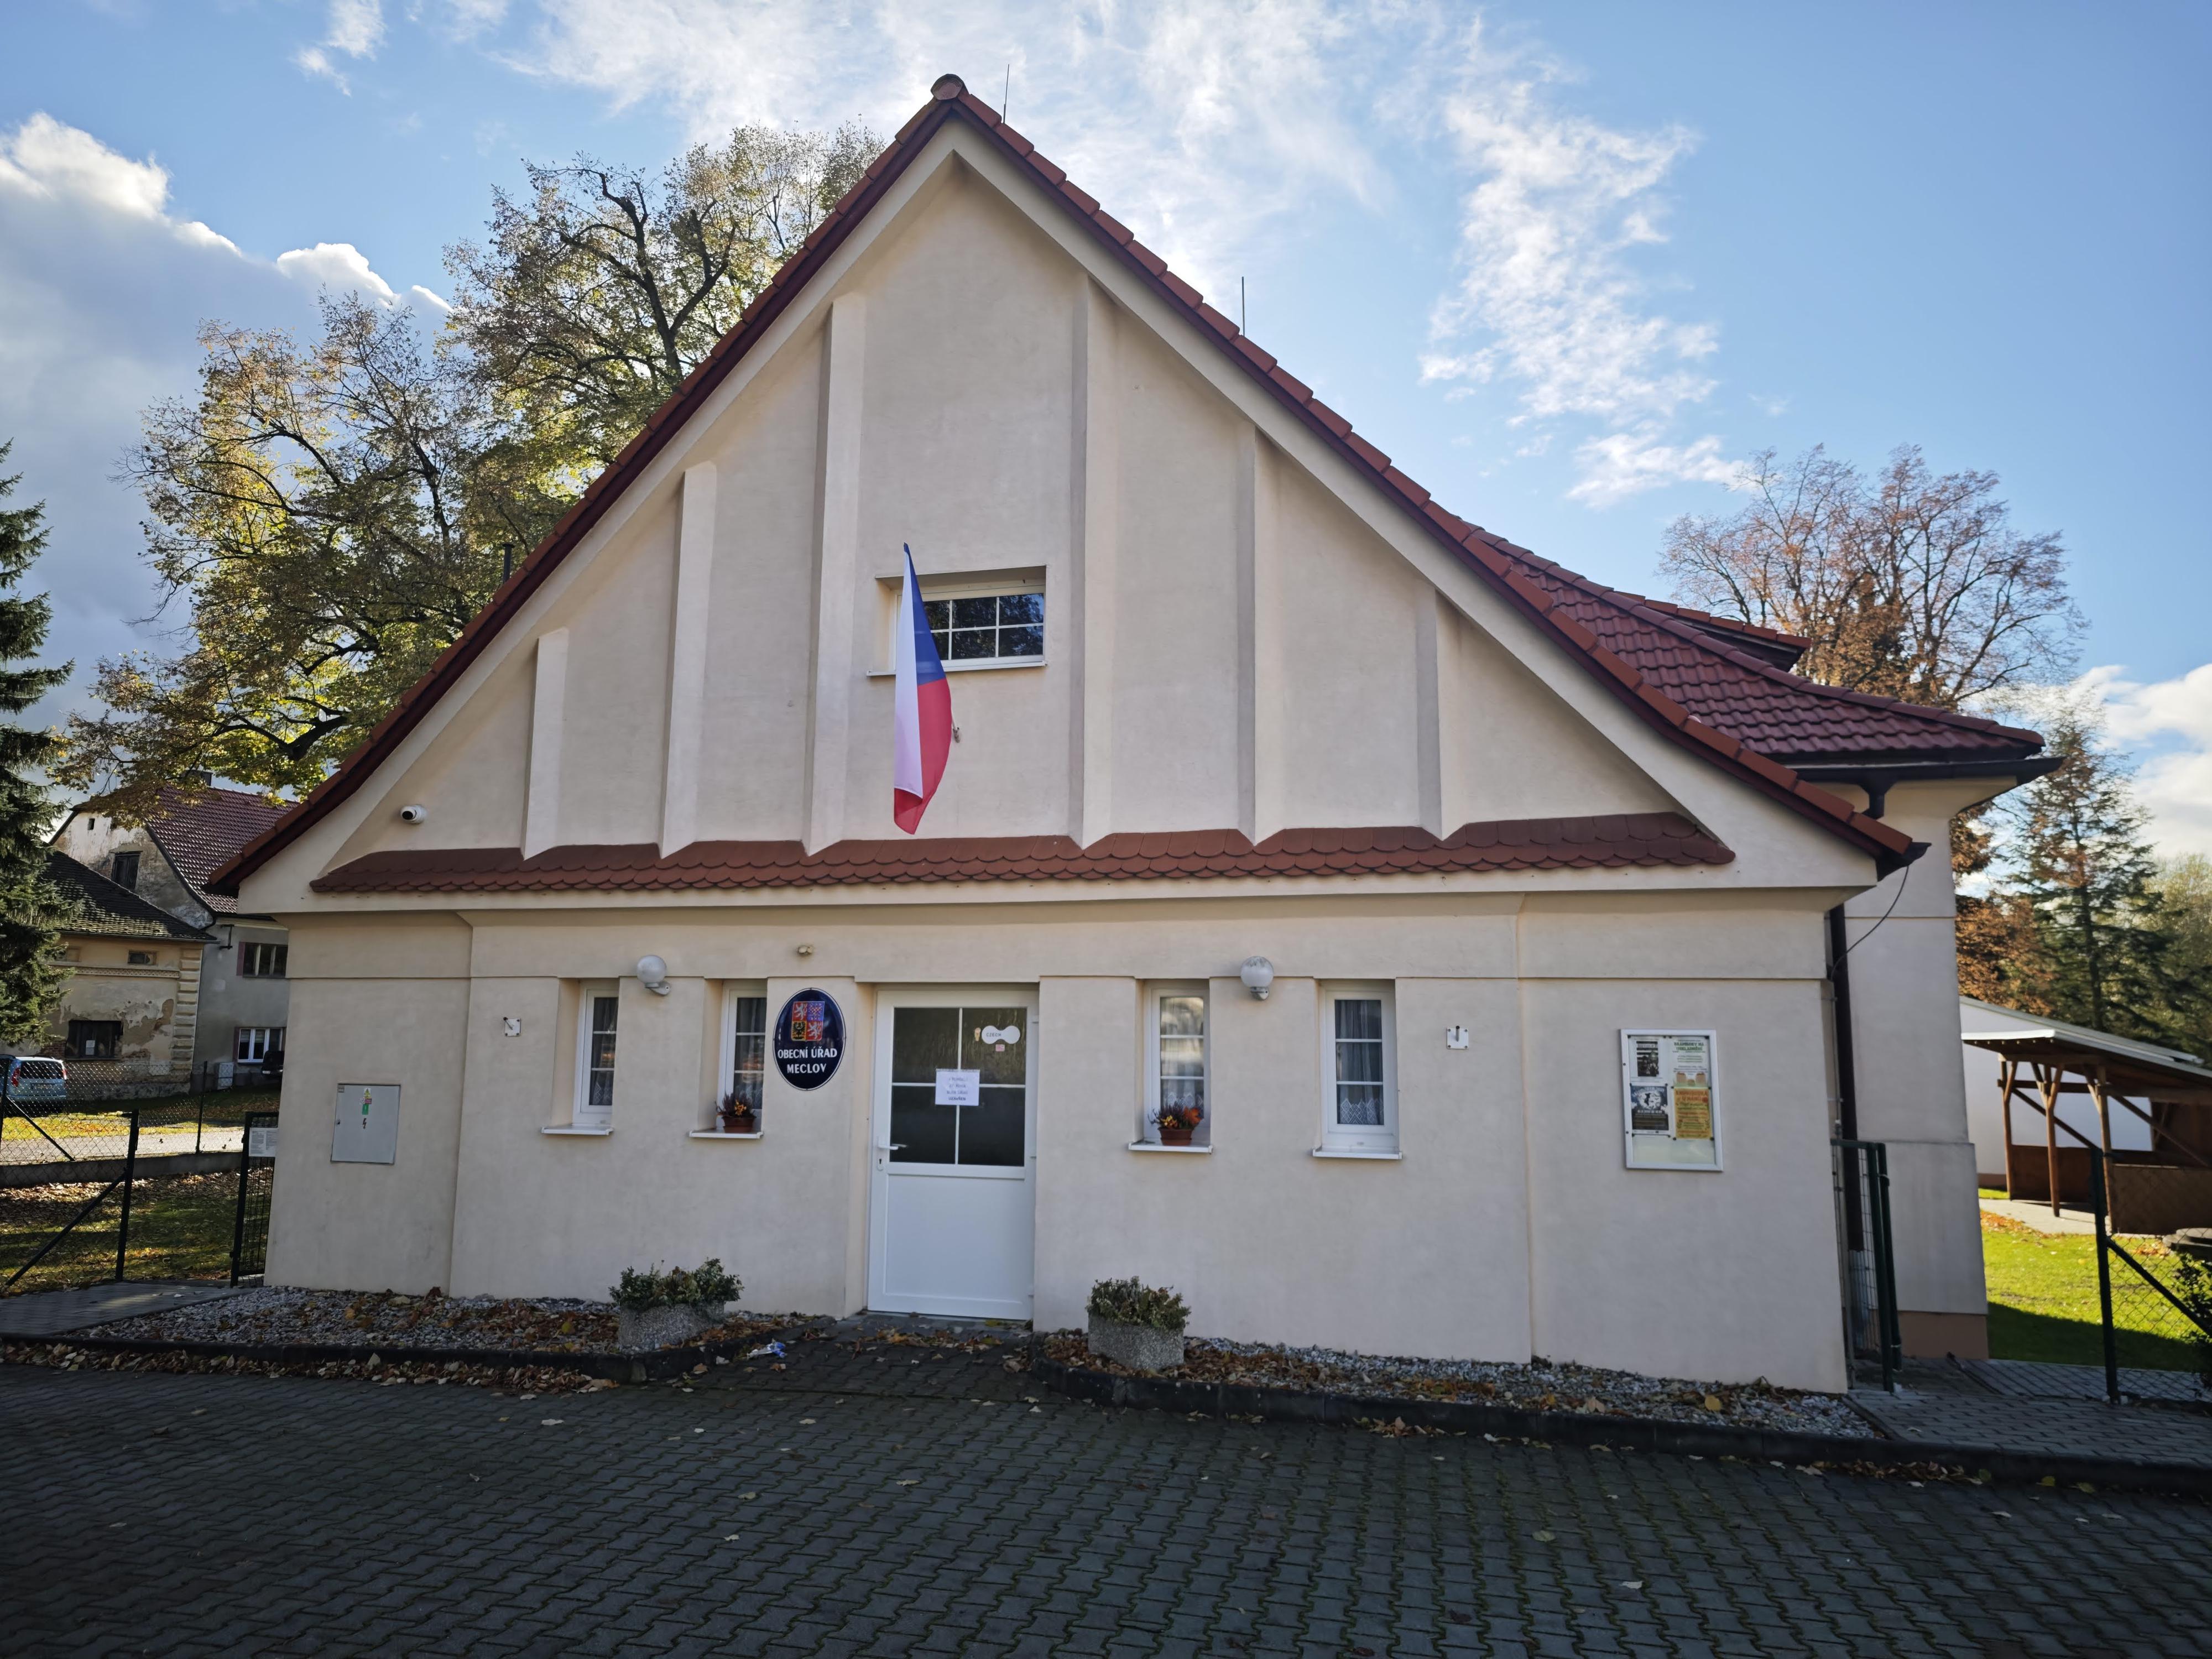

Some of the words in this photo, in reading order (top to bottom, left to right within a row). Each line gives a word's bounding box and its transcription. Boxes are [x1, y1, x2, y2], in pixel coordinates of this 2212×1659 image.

[778, 1047, 808, 1059] OBECNÍ
[811, 1046, 838, 1058] ÚŘAD
[787, 1063, 827, 1074] MECLOV
